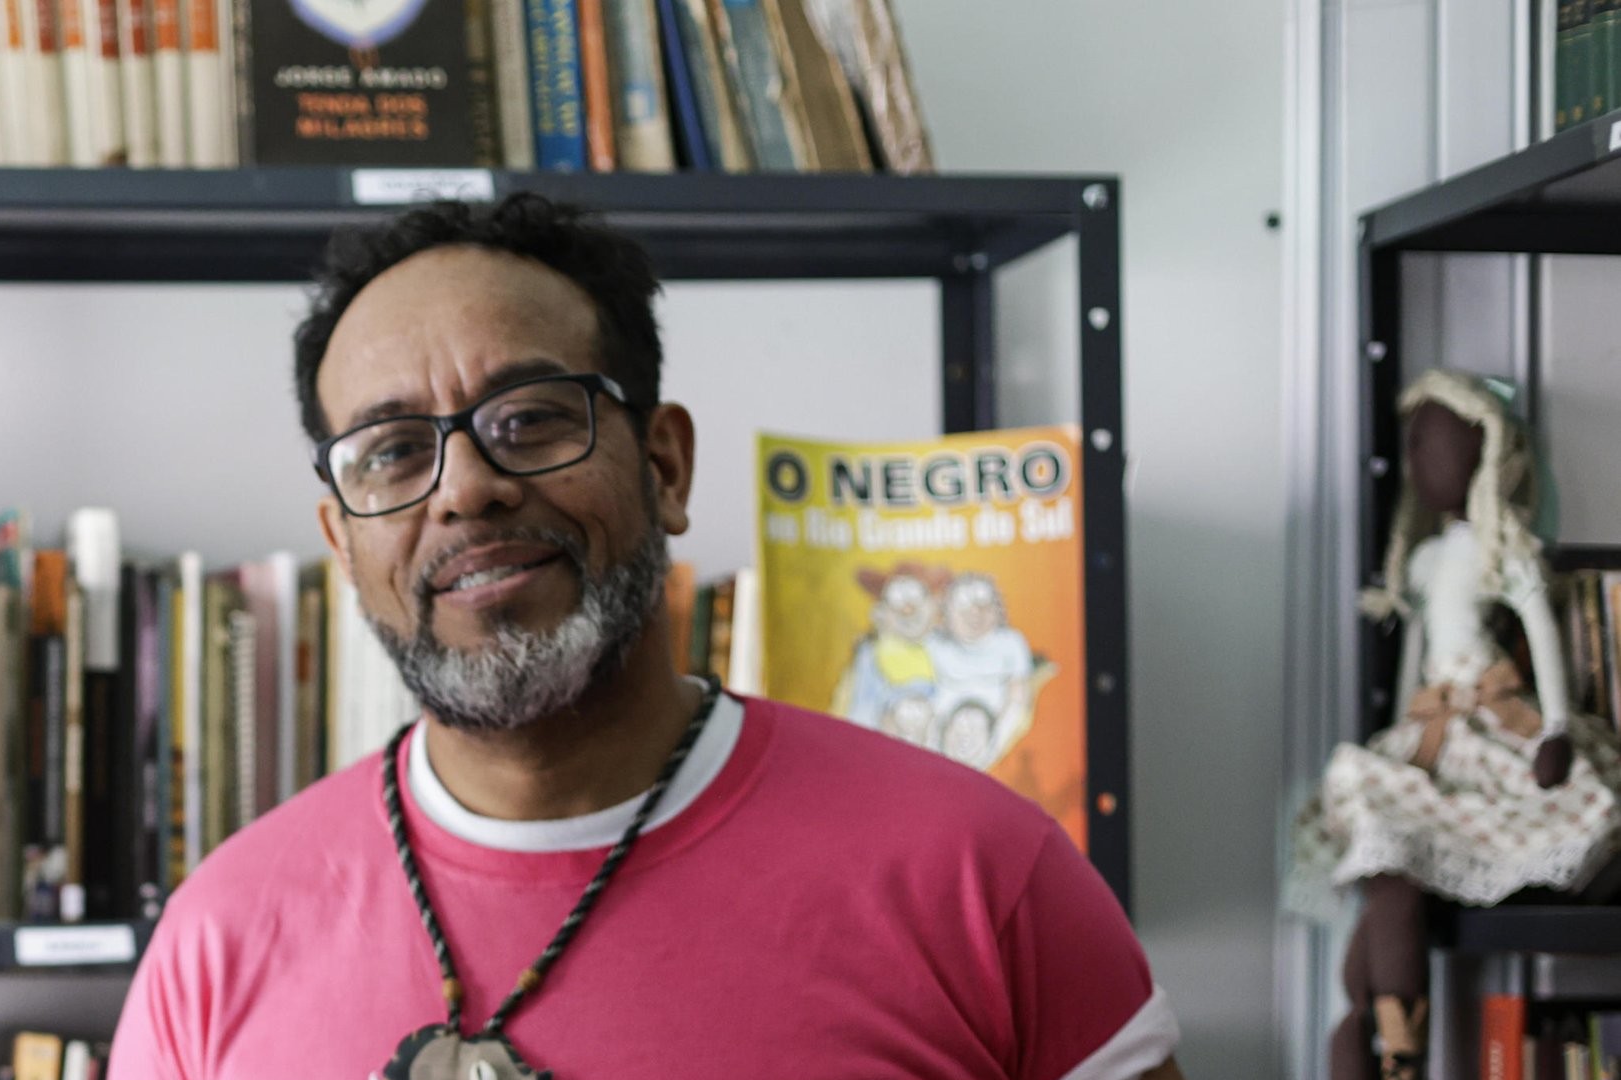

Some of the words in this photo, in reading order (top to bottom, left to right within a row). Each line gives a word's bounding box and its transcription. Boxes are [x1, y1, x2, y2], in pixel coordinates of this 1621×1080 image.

[274, 65, 353, 88] JORGE
[359, 66, 448, 90] AMADO
[374, 93, 428, 115] DOS
[766, 448, 808, 502] O
[831, 443, 1070, 507] NEGRO
[804, 507, 853, 550] Rio
[858, 507, 968, 549] Grande
[973, 503, 1016, 547] do
[1020, 495, 1074, 543] Sul
